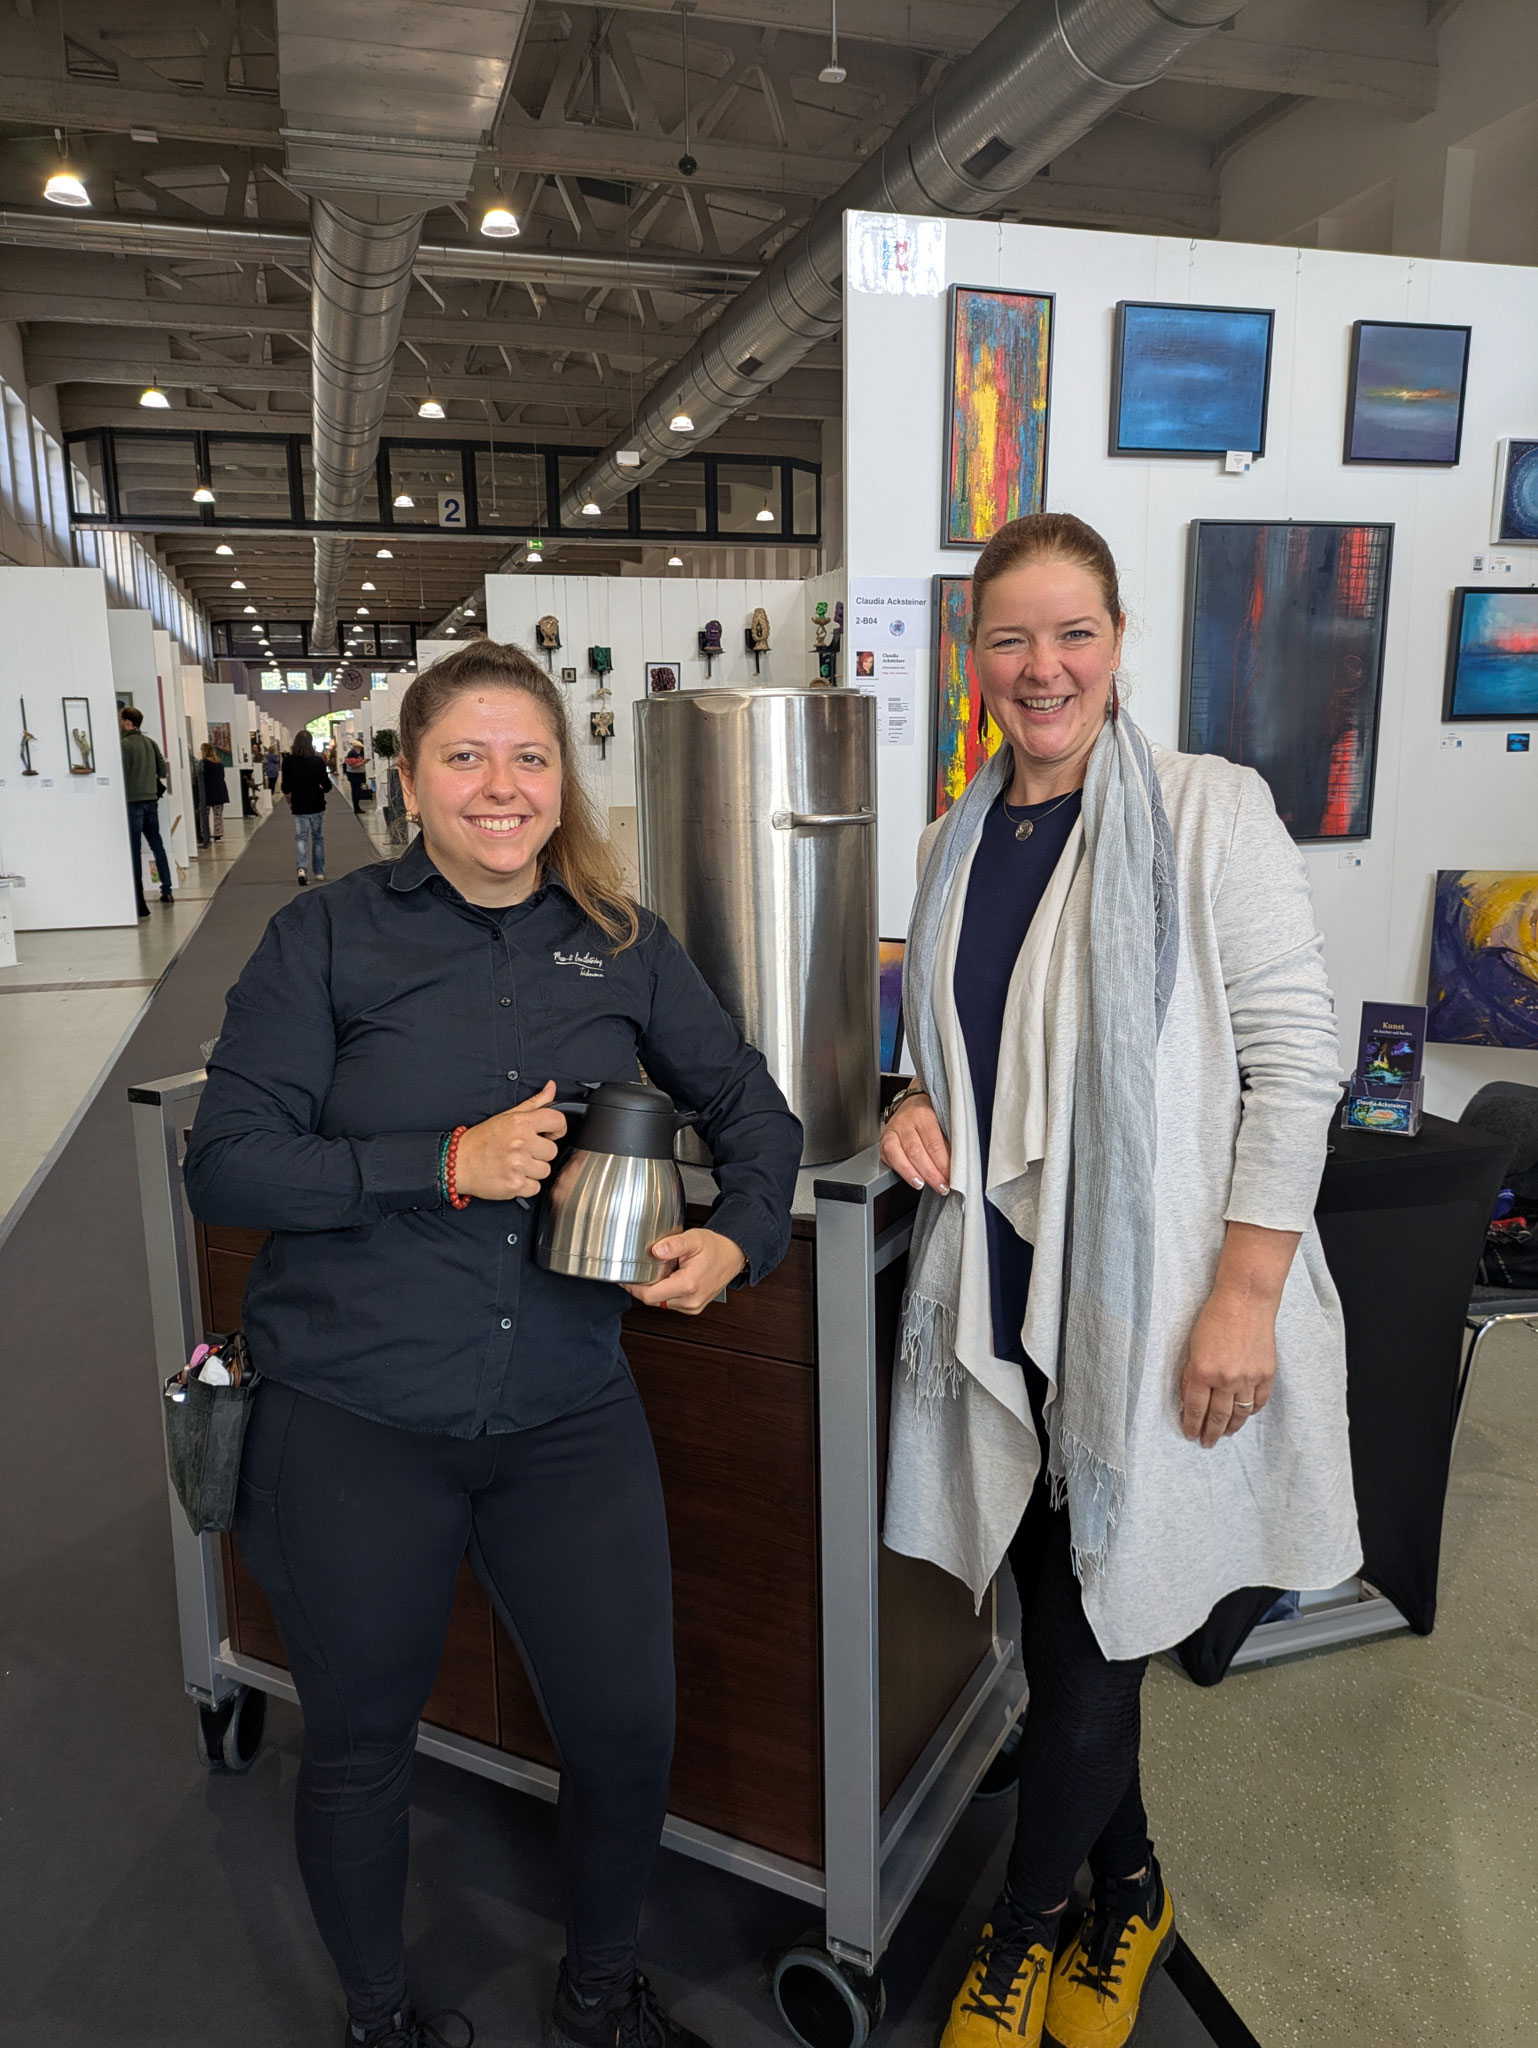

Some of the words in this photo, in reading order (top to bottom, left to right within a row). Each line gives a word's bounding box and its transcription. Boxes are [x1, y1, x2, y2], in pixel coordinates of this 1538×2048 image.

[444, 498, 461, 523] 2
[856, 597, 885, 605] Claudia
[887, 597, 927, 606] Acksteiner
[855, 617, 878, 625] 2-B04
[366, 643, 374, 653] 2
[1382, 1021, 1405, 1030] Kunst
